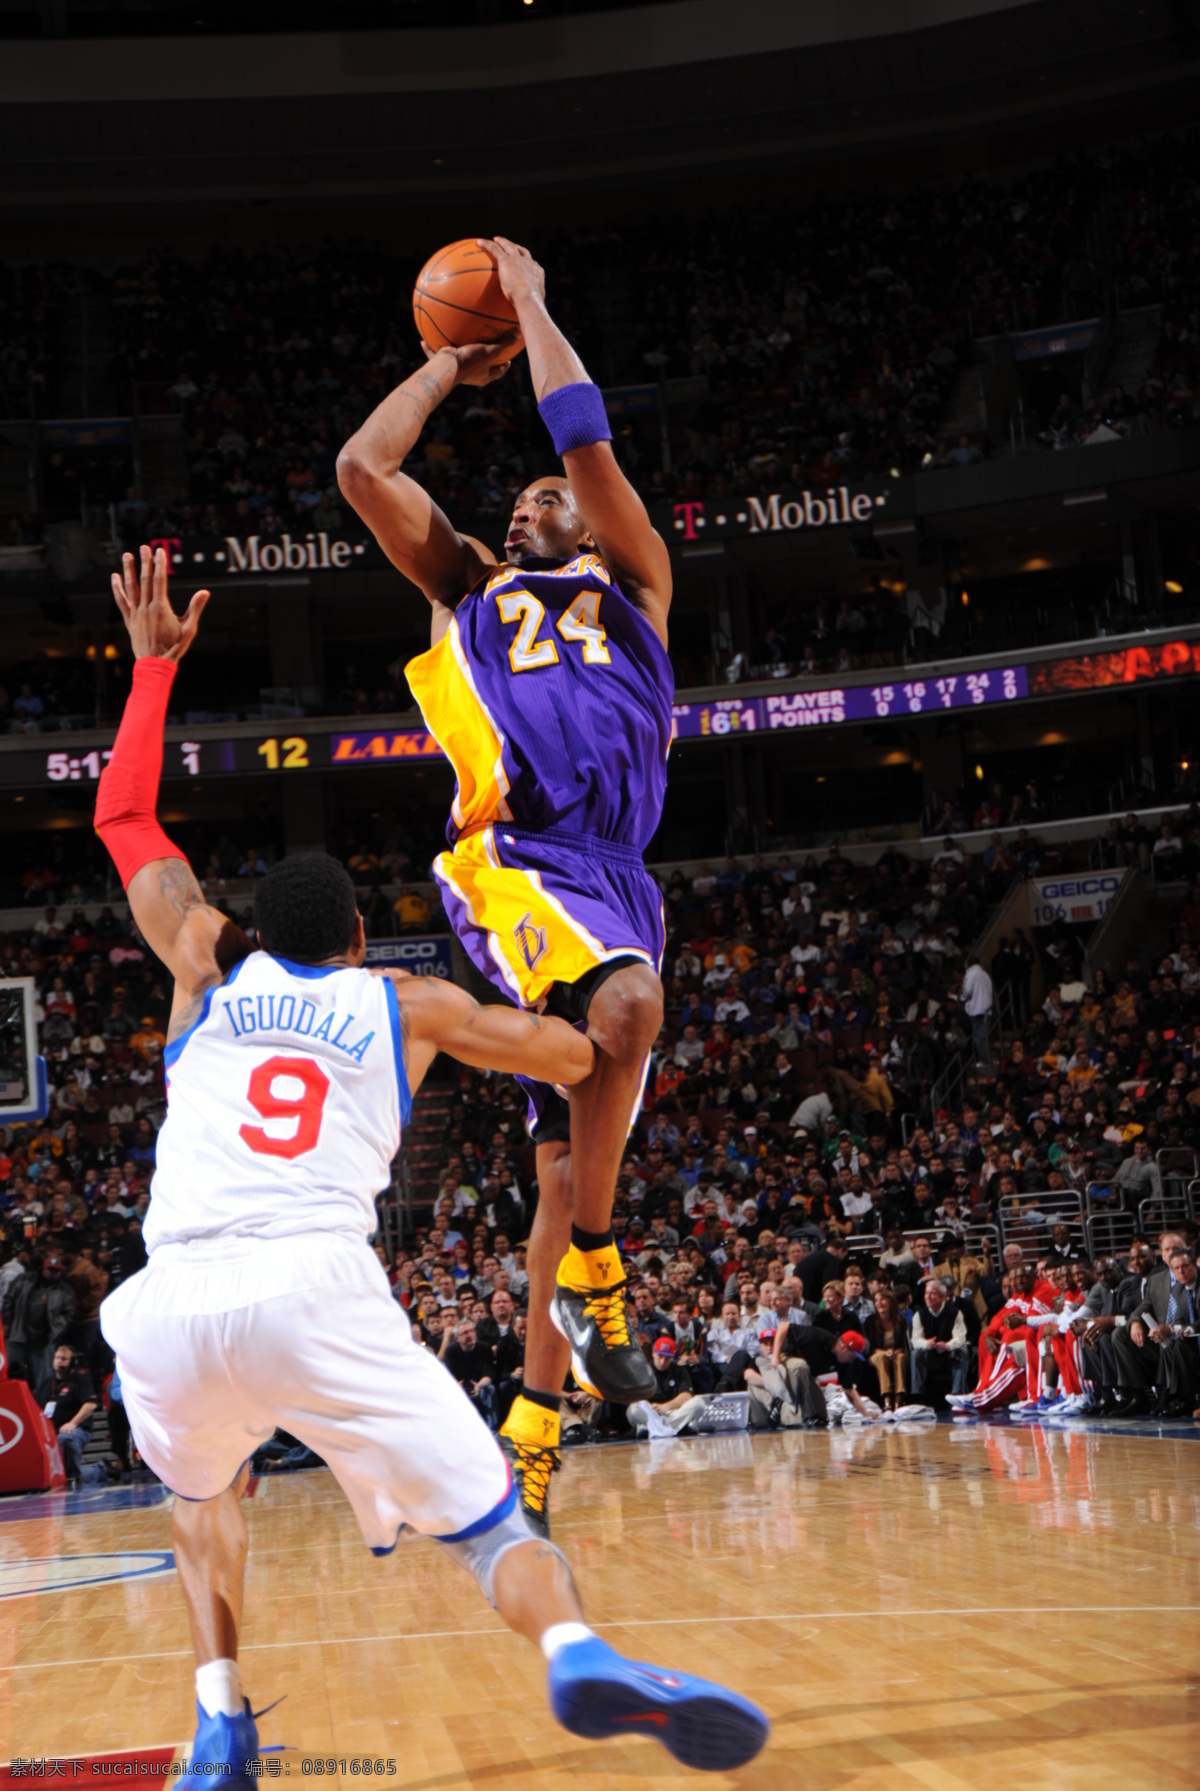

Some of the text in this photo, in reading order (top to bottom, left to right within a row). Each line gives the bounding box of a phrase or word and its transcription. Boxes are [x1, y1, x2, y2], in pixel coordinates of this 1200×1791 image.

[747, 487, 872, 533] Mobile
[225, 533, 351, 572] Mobile
[495, 590, 612, 673] 24
[767, 669, 1016, 712] PLAYER 15 16 17 24 2
[769, 706, 845, 729] POINTS
[876, 701, 890, 717] 0
[941, 693, 952, 708] 1
[1004, 684, 1017, 699] 0
[711, 711, 731, 734] 6
[740, 709, 756, 732] 1
[258, 737, 309, 769] 12
[333, 734, 444, 760] LAKE
[1042, 877, 1119, 899] GEICO
[1034, 903, 1067, 923] 106
[365, 942, 437, 961] GEICO
[414, 960, 448, 978] 106
[223, 995, 376, 1063] IGUODALA
[238, 1055, 331, 1161] 9
